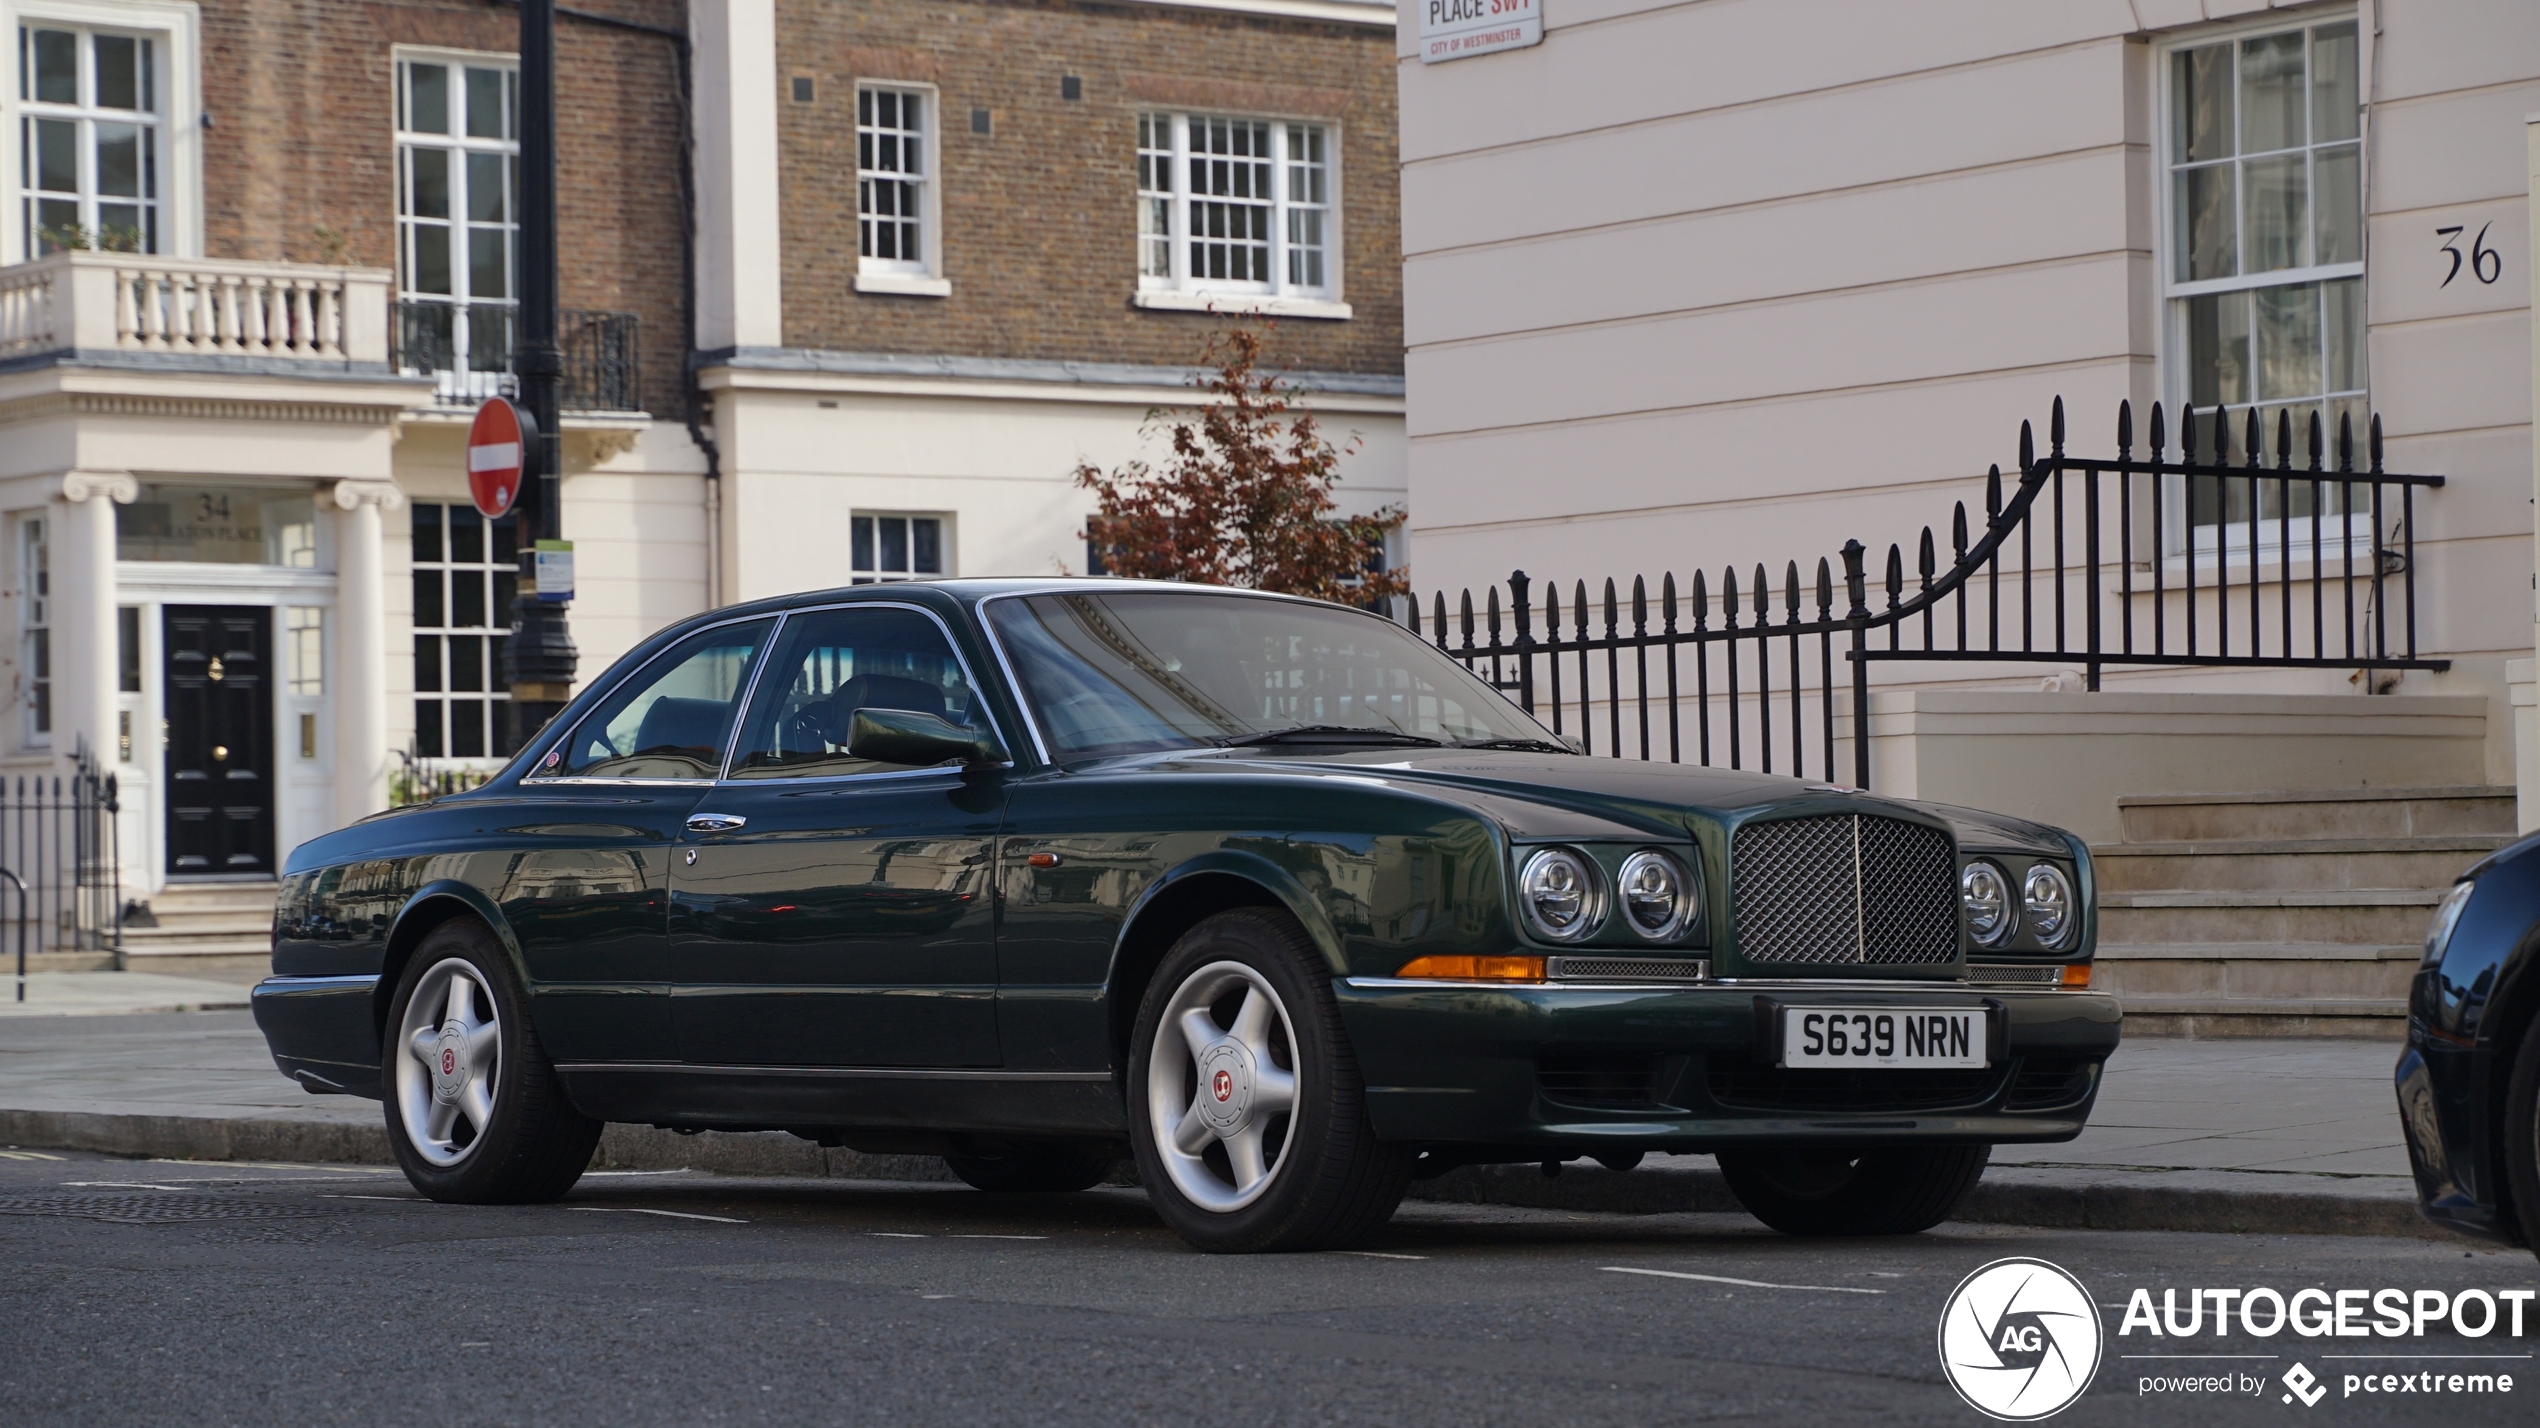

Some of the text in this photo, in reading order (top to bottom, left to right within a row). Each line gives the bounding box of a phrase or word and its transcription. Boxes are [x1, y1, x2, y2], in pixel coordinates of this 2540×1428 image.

[1430, 0, 1483, 25] PLACE
[1430, 28, 1521, 55] CITY OF WESTMINSTER
[2435, 219, 2501, 290] 36
[196, 492, 231, 522] 34
[1803, 1014, 1969, 1057] S639 NRN
